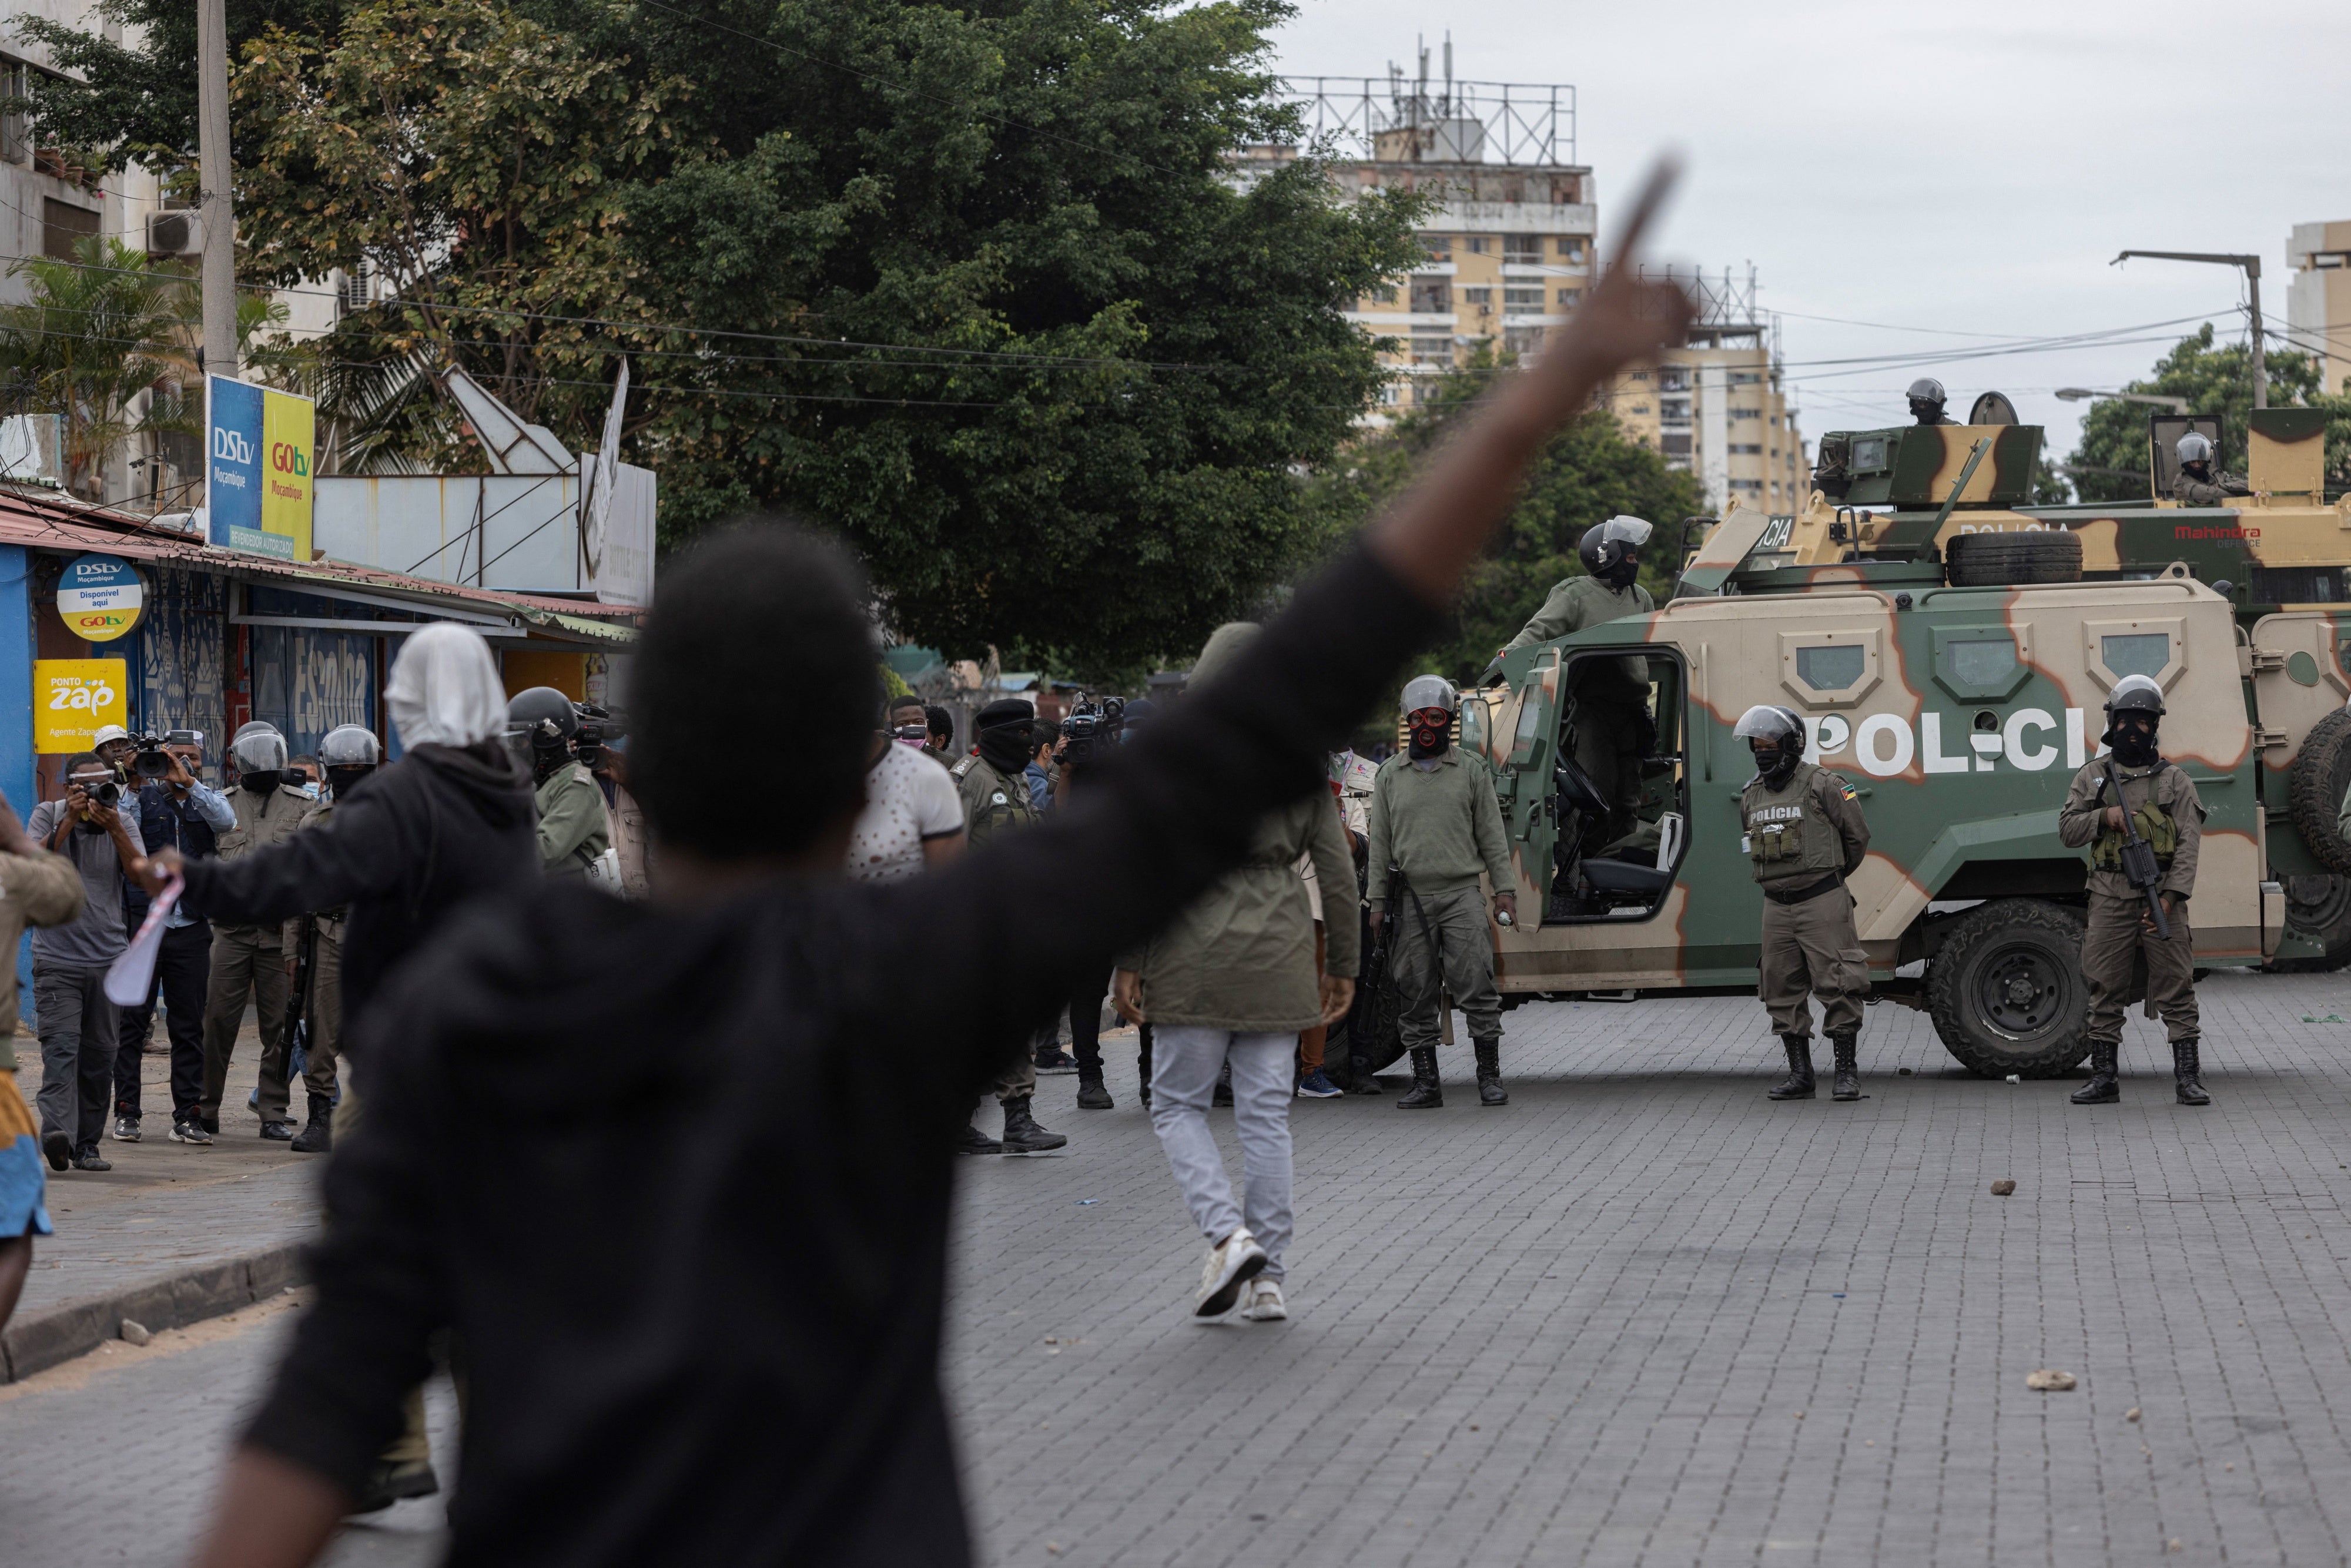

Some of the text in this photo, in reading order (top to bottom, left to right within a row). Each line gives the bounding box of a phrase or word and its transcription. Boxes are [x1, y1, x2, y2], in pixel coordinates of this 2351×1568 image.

[272, 442, 310, 477] GOtv
[214, 467, 246, 490] Moçambique
[272, 480, 302, 502] Moçambique
[2175, 525, 2260, 539] Mahindra
[231, 531, 293, 554] REVENDEDOR AUTORIZADO
[2218, 539, 2260, 548] DEFENCE
[80, 589, 119, 599] Disponível
[92, 599, 108, 607] aqui
[80, 616, 126, 627] GOtv
[51, 677, 81, 686] PONTO
[49, 686, 114, 716] zap
[49, 728, 76, 737] Agente
[1750, 806, 1801, 823] POLÍCIA
